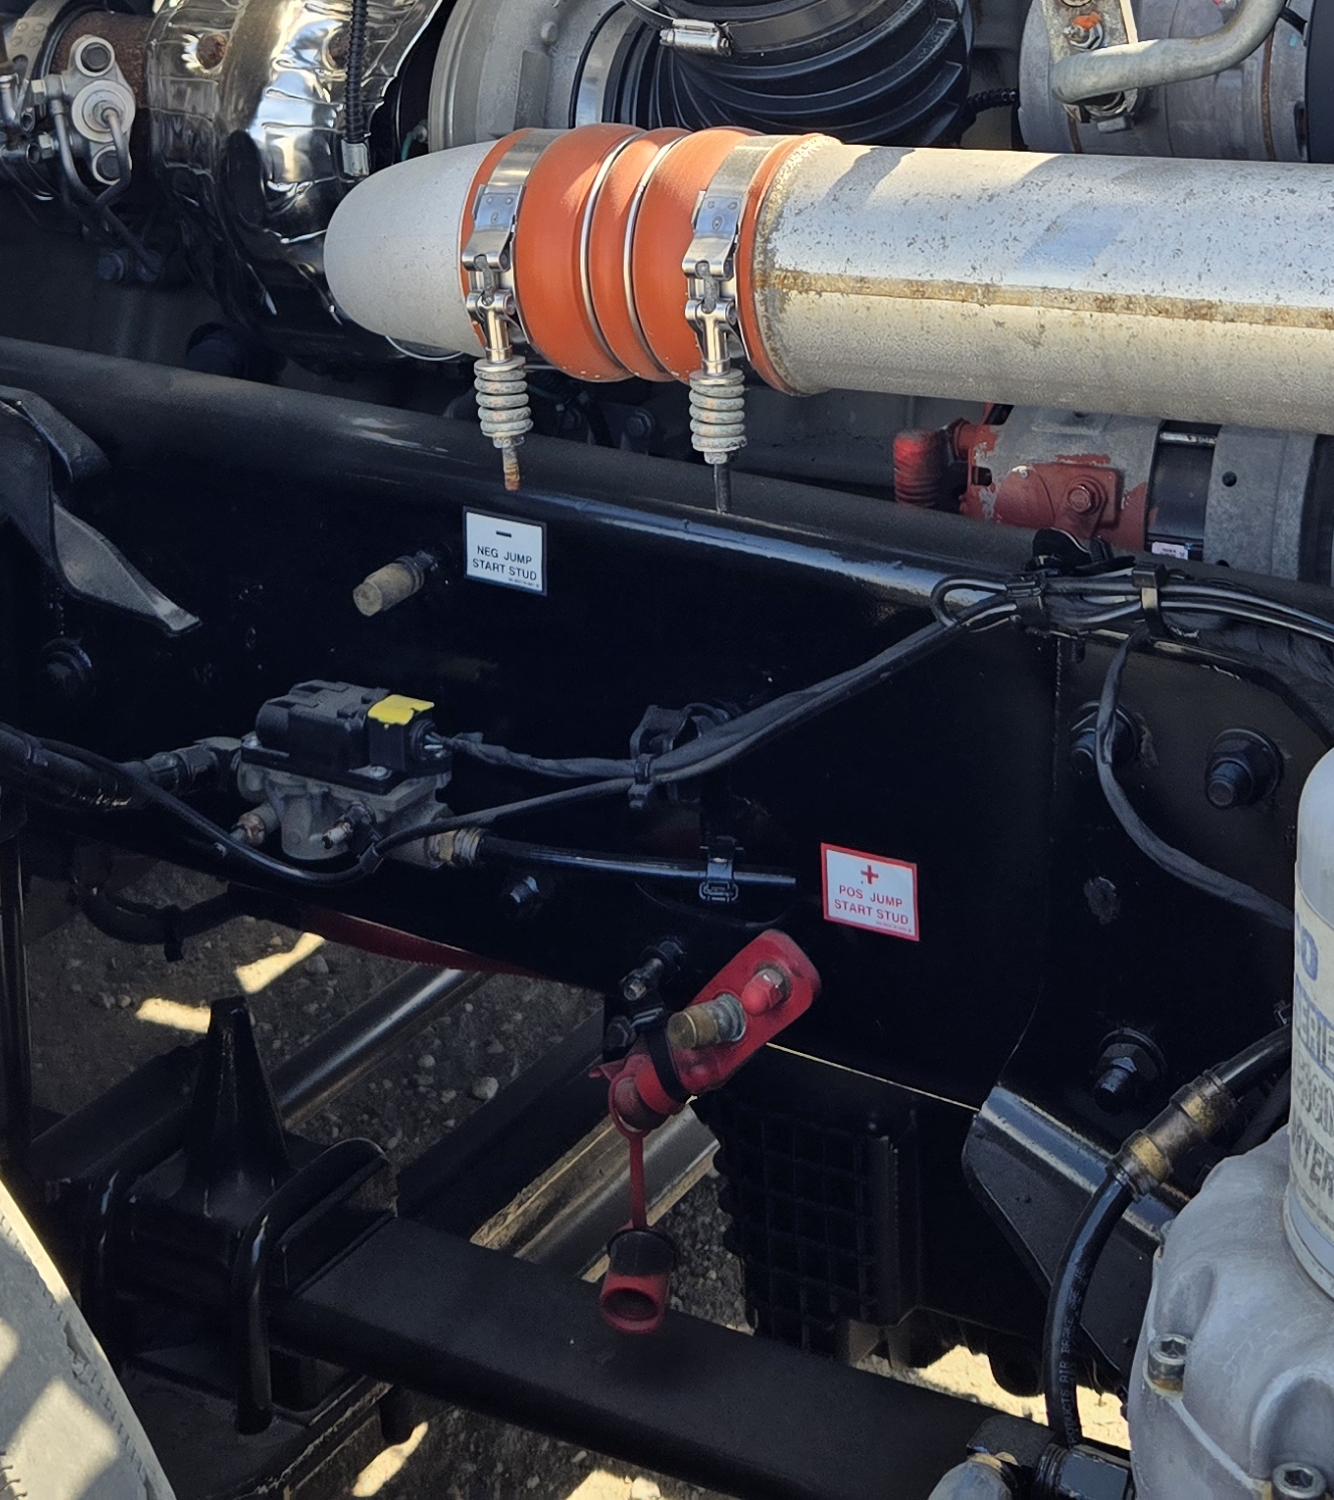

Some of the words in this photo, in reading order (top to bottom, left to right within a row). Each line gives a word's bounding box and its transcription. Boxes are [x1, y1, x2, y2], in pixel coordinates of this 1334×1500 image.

[477, 544, 499, 558] NEG
[503, 551, 532, 565] JUMP
[472, 558, 506, 574] START
[508, 566, 537, 581] STUD
[839, 884, 863, 900] POS
[869, 892, 903, 908] JUMP
[834, 898, 873, 917] START
[876, 908, 909, 925] STUD
[1059, 1359, 1070, 1383] AIR
